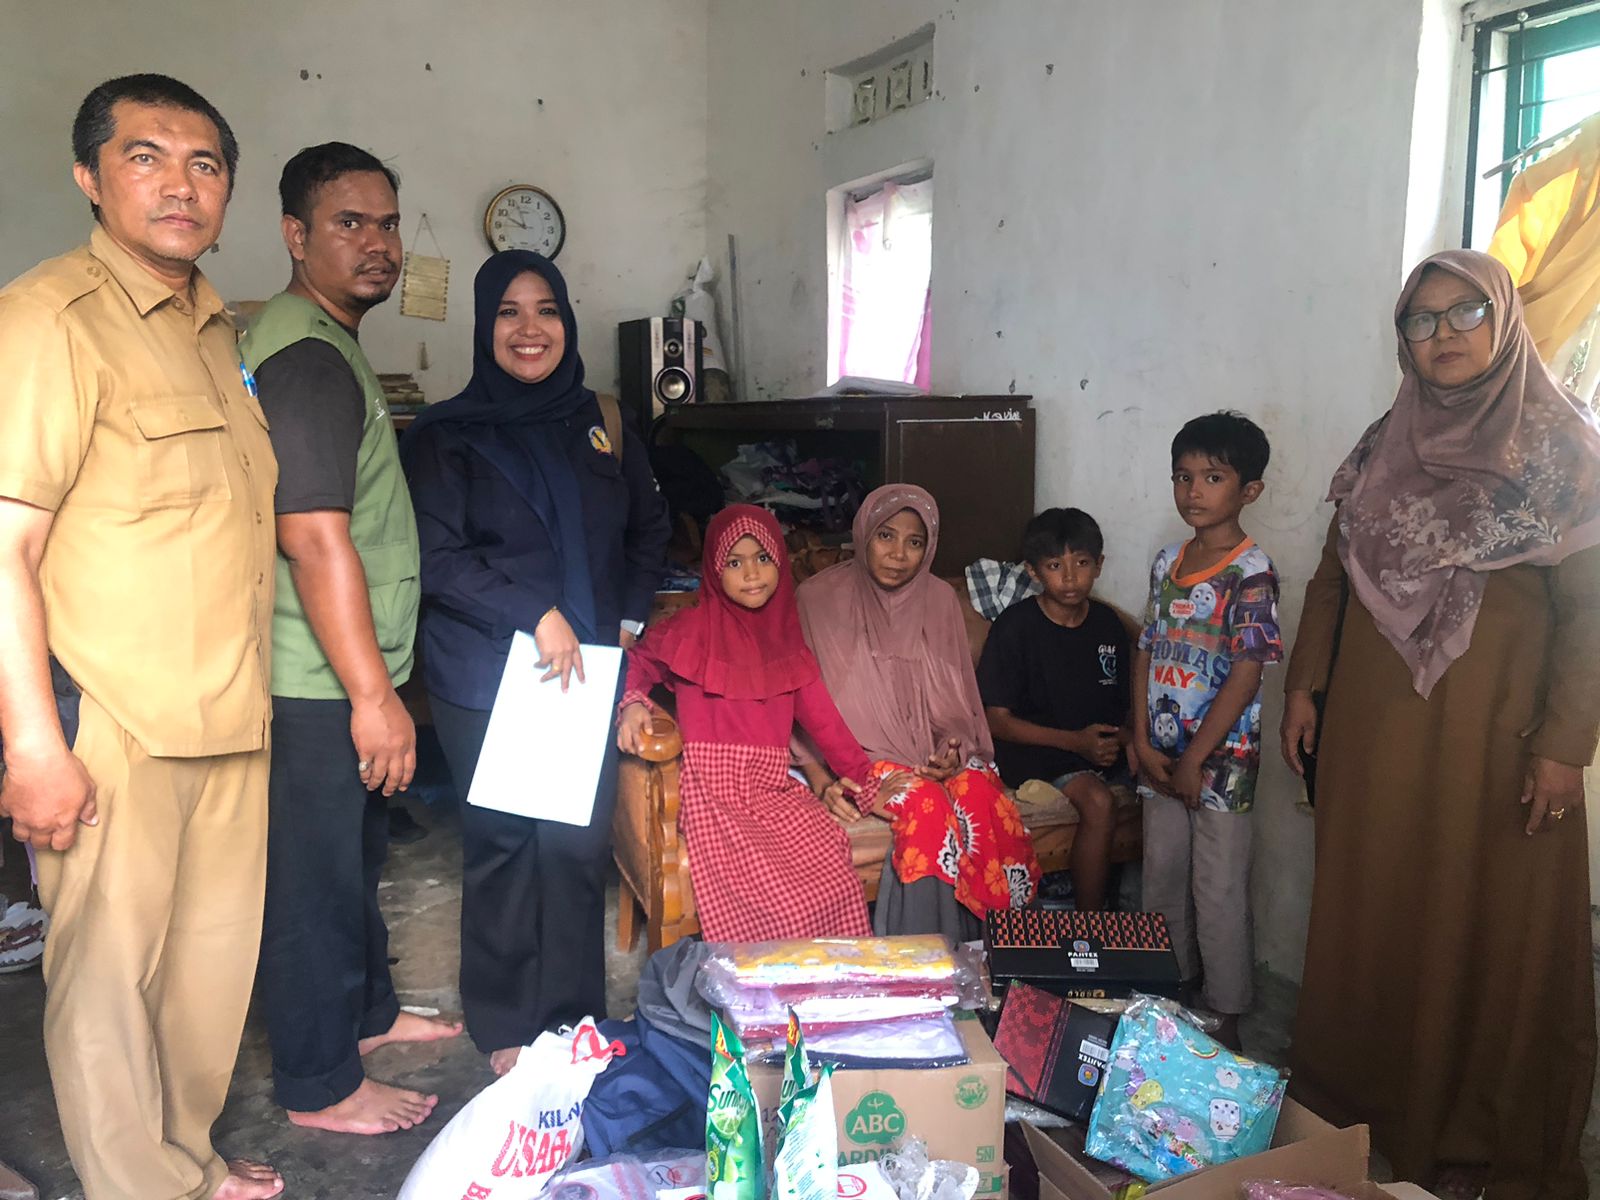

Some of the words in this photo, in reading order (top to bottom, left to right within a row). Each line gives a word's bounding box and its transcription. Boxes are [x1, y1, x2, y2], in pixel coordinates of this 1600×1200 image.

[507, 199, 515, 207] 11
[520, 195, 532, 204] 12
[498, 208, 508, 217] 10
[543, 212, 551, 220] 2
[494, 221, 502, 229] 9
[547, 226, 554, 234] 3
[498, 234, 506, 242] 8
[542, 239, 549, 247] 4
[1154, 665, 1197, 689] WAY
[851, 1113, 900, 1135] ABC
